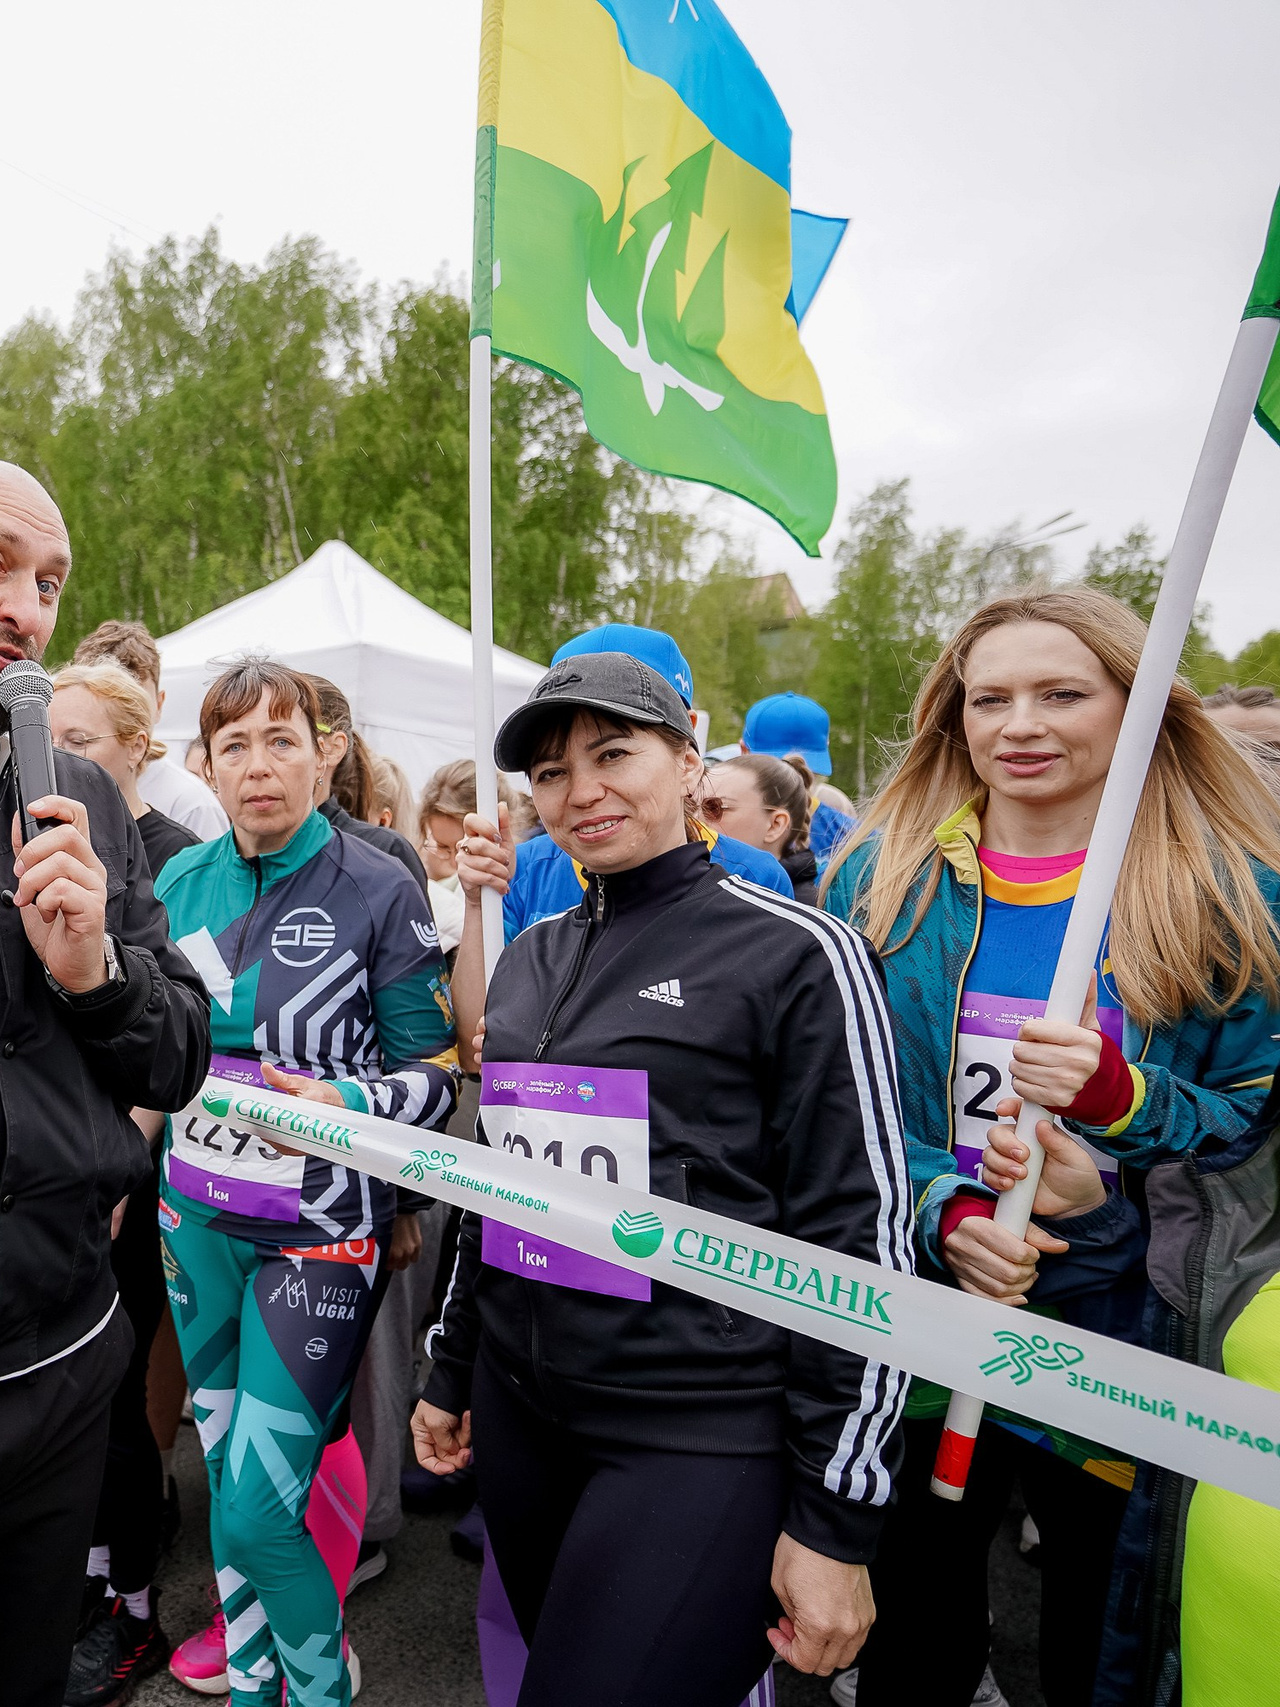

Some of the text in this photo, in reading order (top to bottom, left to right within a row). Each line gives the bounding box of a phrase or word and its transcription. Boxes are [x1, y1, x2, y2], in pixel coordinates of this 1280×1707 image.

[638, 988, 685, 1008] adidas
[235, 1098, 359, 1150] СБЕРБАНК
[440, 1169, 550, 1214] ЗЕЛЕНЫЙ МАРАФОН
[322, 1285, 362, 1304] VISIT
[673, 1228, 893, 1325] СБЕРБАНК
[315, 1301, 356, 1321] UGRA
[1066, 1371, 1177, 1422] ЗЕЛЕНЫЙ
